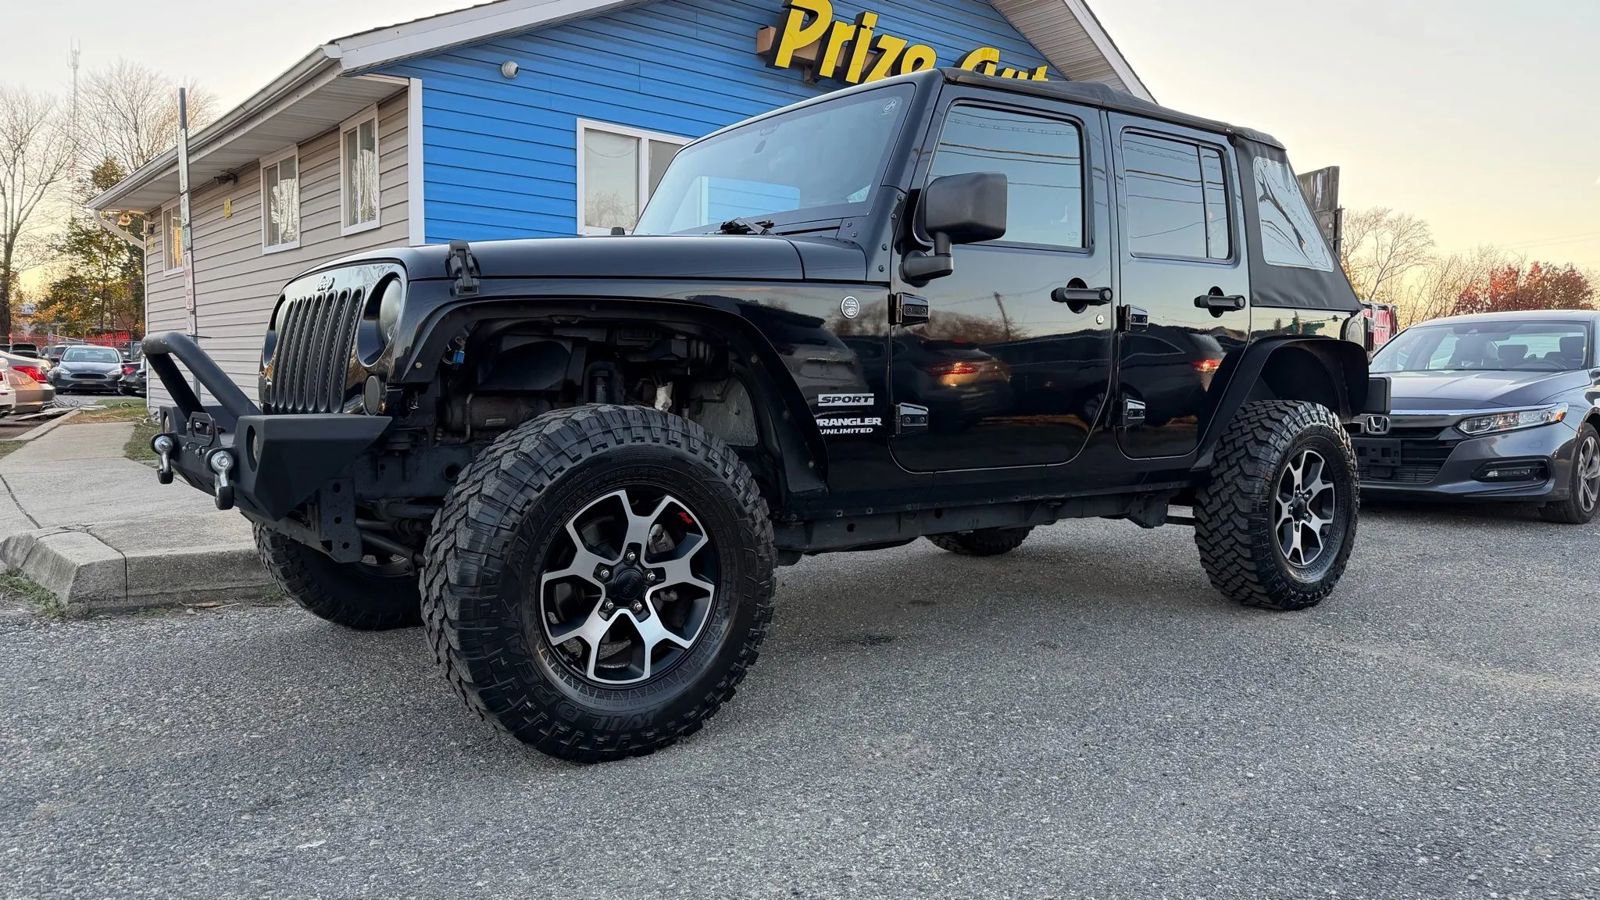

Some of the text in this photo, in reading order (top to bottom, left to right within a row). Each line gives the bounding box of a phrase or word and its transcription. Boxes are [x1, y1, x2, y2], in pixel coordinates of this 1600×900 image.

[774, 0, 937, 84] Prize
[818, 395, 874, 404] SPORT
[820, 427, 873, 435] UNLIMITED
